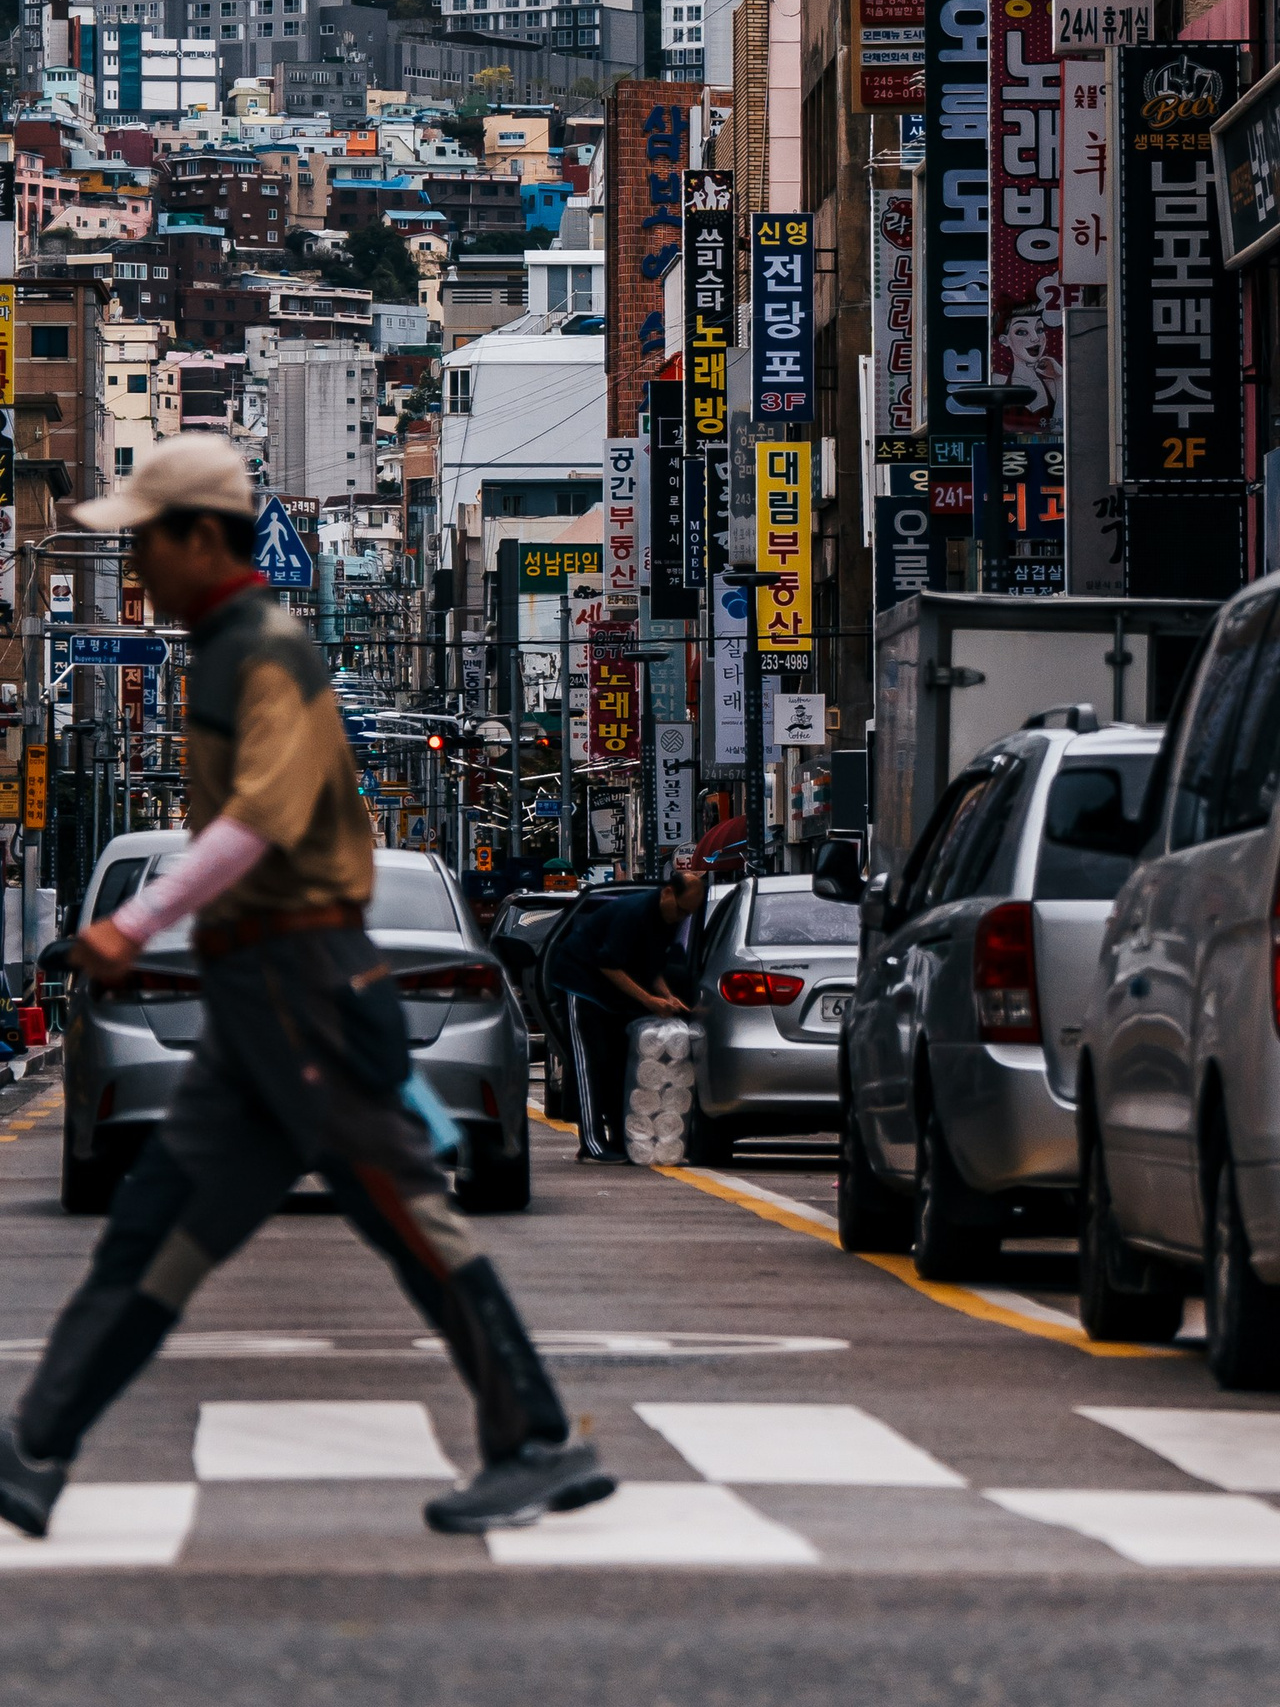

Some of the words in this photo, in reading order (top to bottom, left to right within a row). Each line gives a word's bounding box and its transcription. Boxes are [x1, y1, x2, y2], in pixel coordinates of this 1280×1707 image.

[757, 221, 808, 246] 신영
[694, 228, 726, 312] 쓰리스타
[1152, 161, 1215, 430] 남포맥주
[761, 254, 806, 384] 전당포
[692, 314, 728, 435] 노래방
[760, 392, 807, 412] 3F
[1162, 437, 1207, 469] 2F
[668, 456, 681, 546] 세이로무시
[524, 551, 599, 578] 성남타일
[690, 521, 701, 581] MOTEL
[1013, 564, 1063, 582] 삼겹살
[668, 577, 680, 587] 2F
[722, 637, 745, 713] 실타래
[761, 654, 809, 671] 253-4989
[595, 664, 633, 752] 노래방
